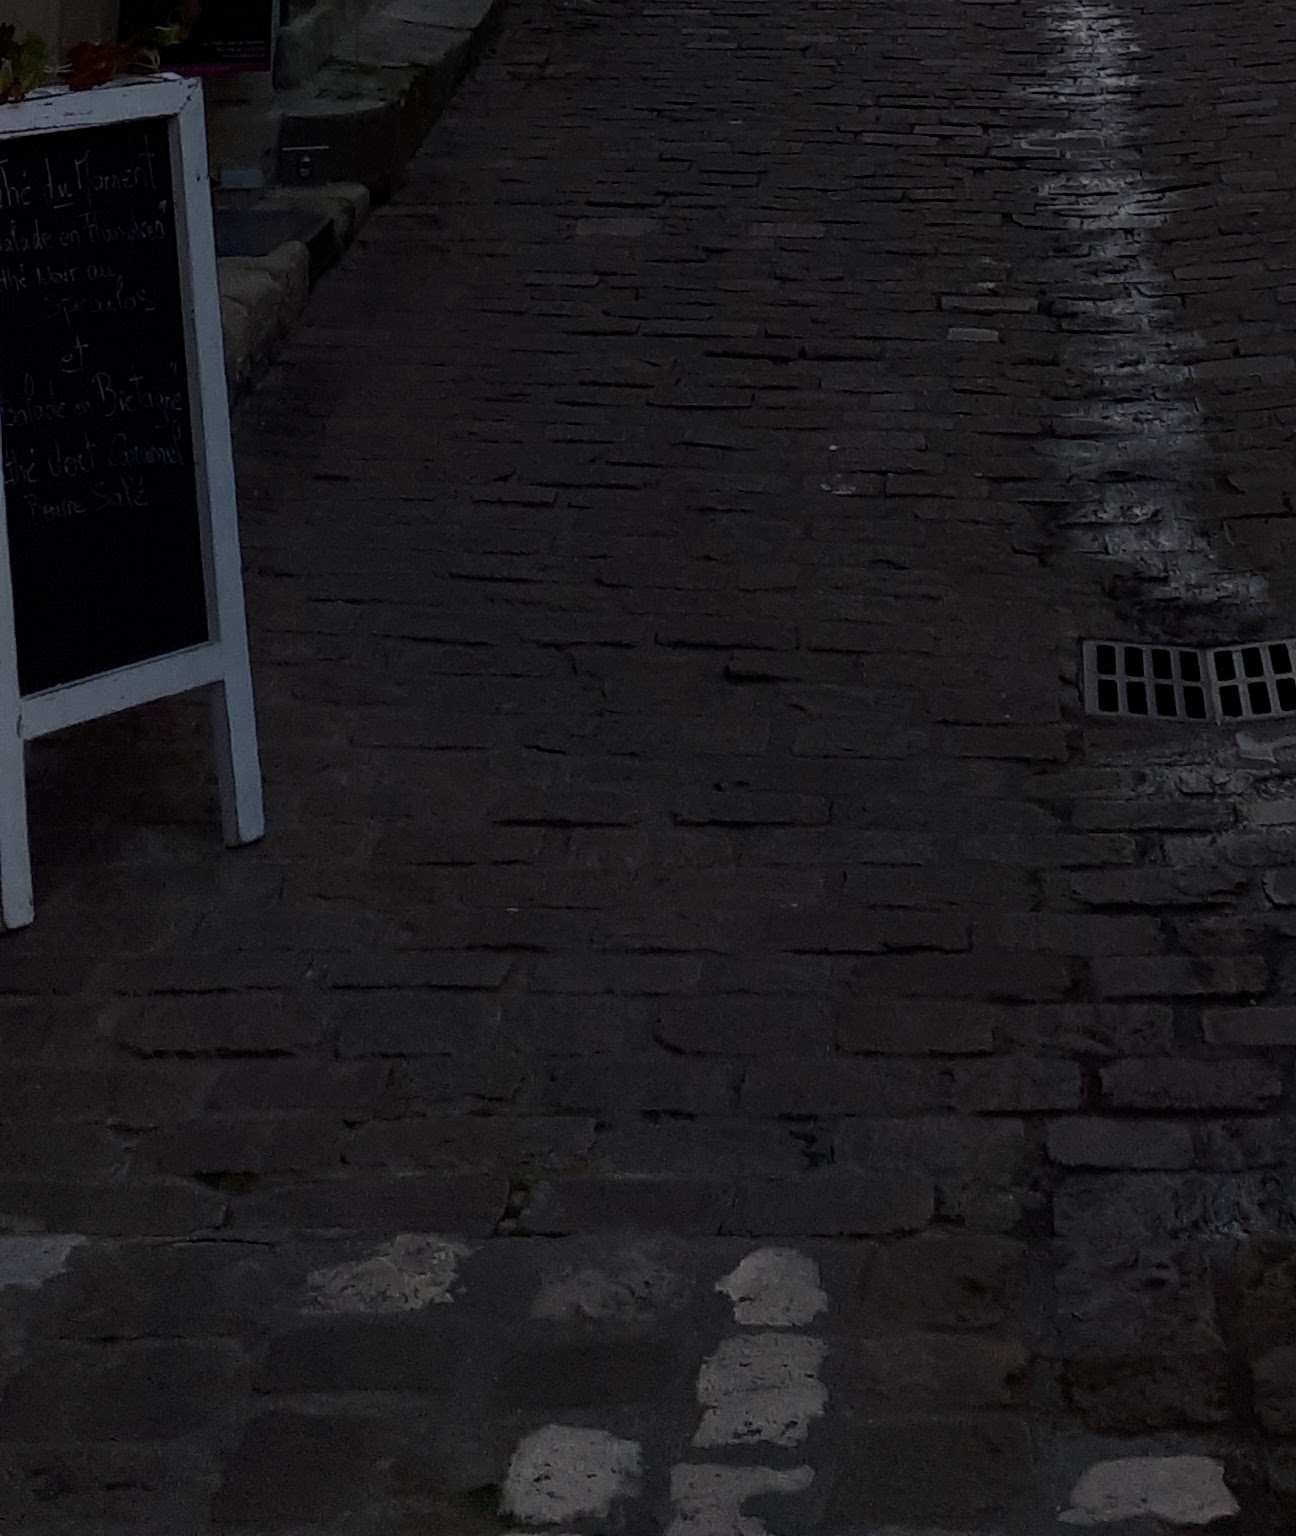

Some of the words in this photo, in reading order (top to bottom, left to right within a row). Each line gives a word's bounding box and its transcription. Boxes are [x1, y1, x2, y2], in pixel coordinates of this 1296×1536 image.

[44, 156, 74, 202] du
[0, 216, 52, 252] alade
[58, 333, 91, 374] et
